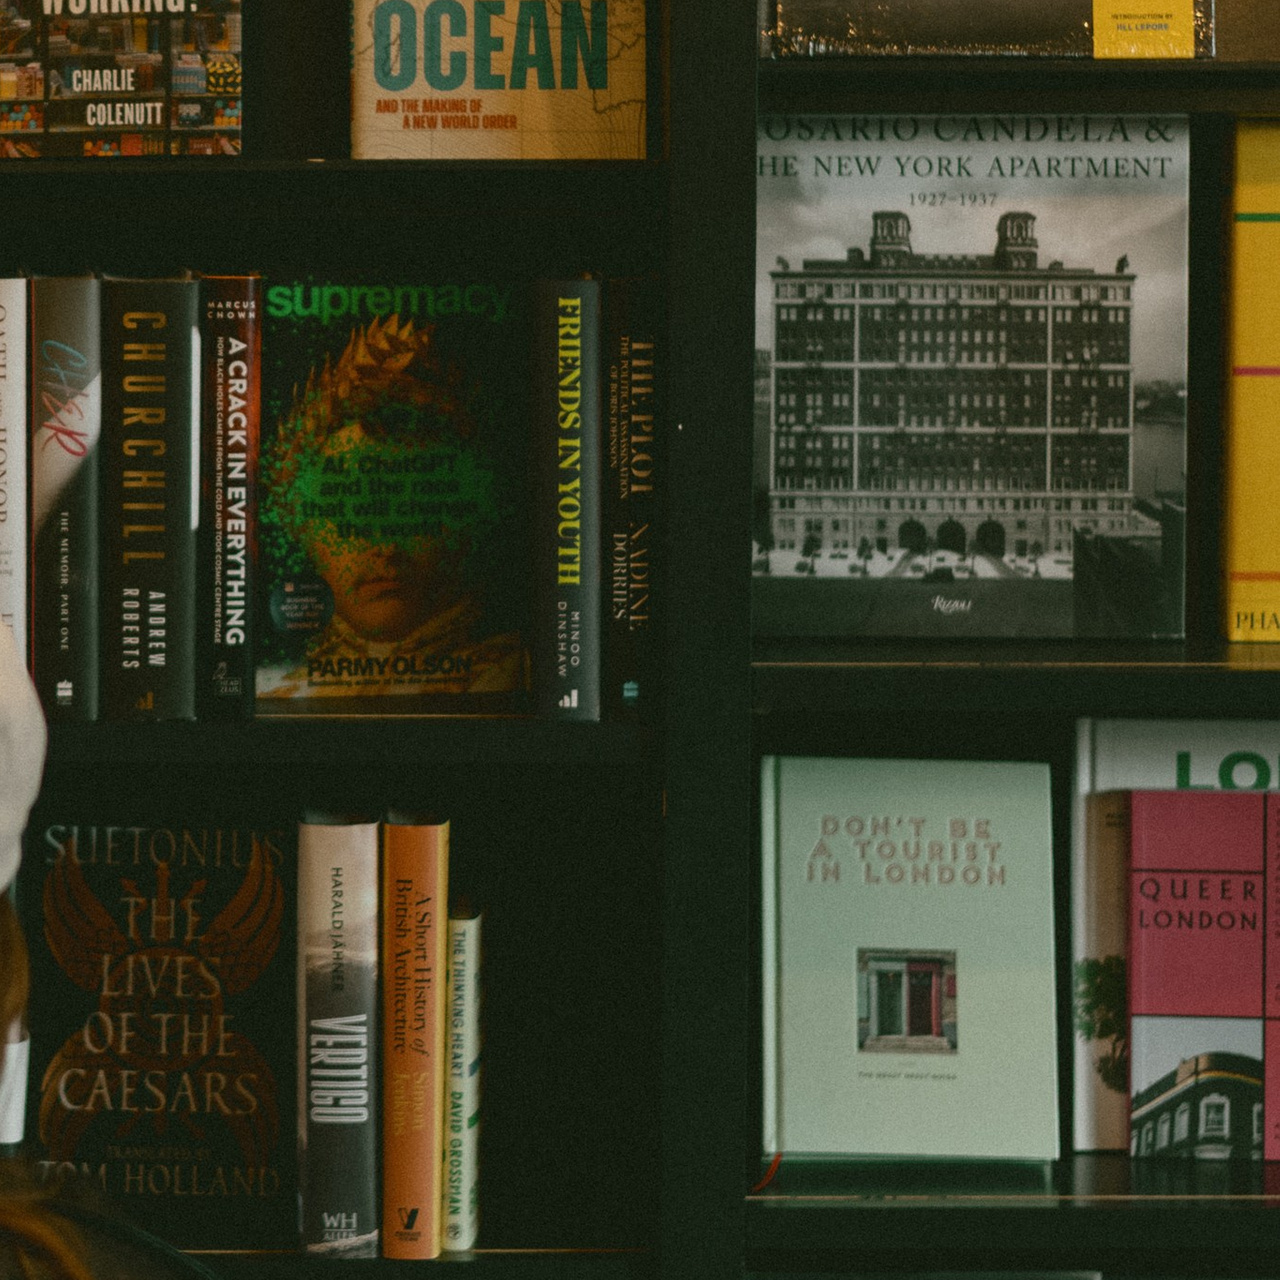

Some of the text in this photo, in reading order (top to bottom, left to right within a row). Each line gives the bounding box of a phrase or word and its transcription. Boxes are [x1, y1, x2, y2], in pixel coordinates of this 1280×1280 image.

[373, 0, 608, 91] OCEAN
[72, 70, 135, 92] CHARLIE
[87, 103, 164, 126] COLENUTT
[933, 117, 1132, 142] CANDELA
[813, 156, 1173, 178] NEW YORK APARTMENT
[207, 301, 256, 309] MARCUS
[265, 284, 513, 323] supremacy
[122, 311, 167, 564] CHURCHILL
[557, 298, 581, 585] FRIENDS IN YOUTH
[227, 337, 247, 645] A CRACK IN EVERYTHING
[123, 589, 140, 669] ROBERTS
[148, 590, 165, 667] ANDREW
[45, 825, 285, 867] SUETONIUS
[1140, 879, 1257, 901] QUEER
[120, 898, 207, 941] THE
[1140, 911, 1258, 930] LONDON
[101, 956, 220, 998] LIVES
[310, 1014, 368, 1124] VERTIGO
[57, 1069, 257, 1115] CAESARS
